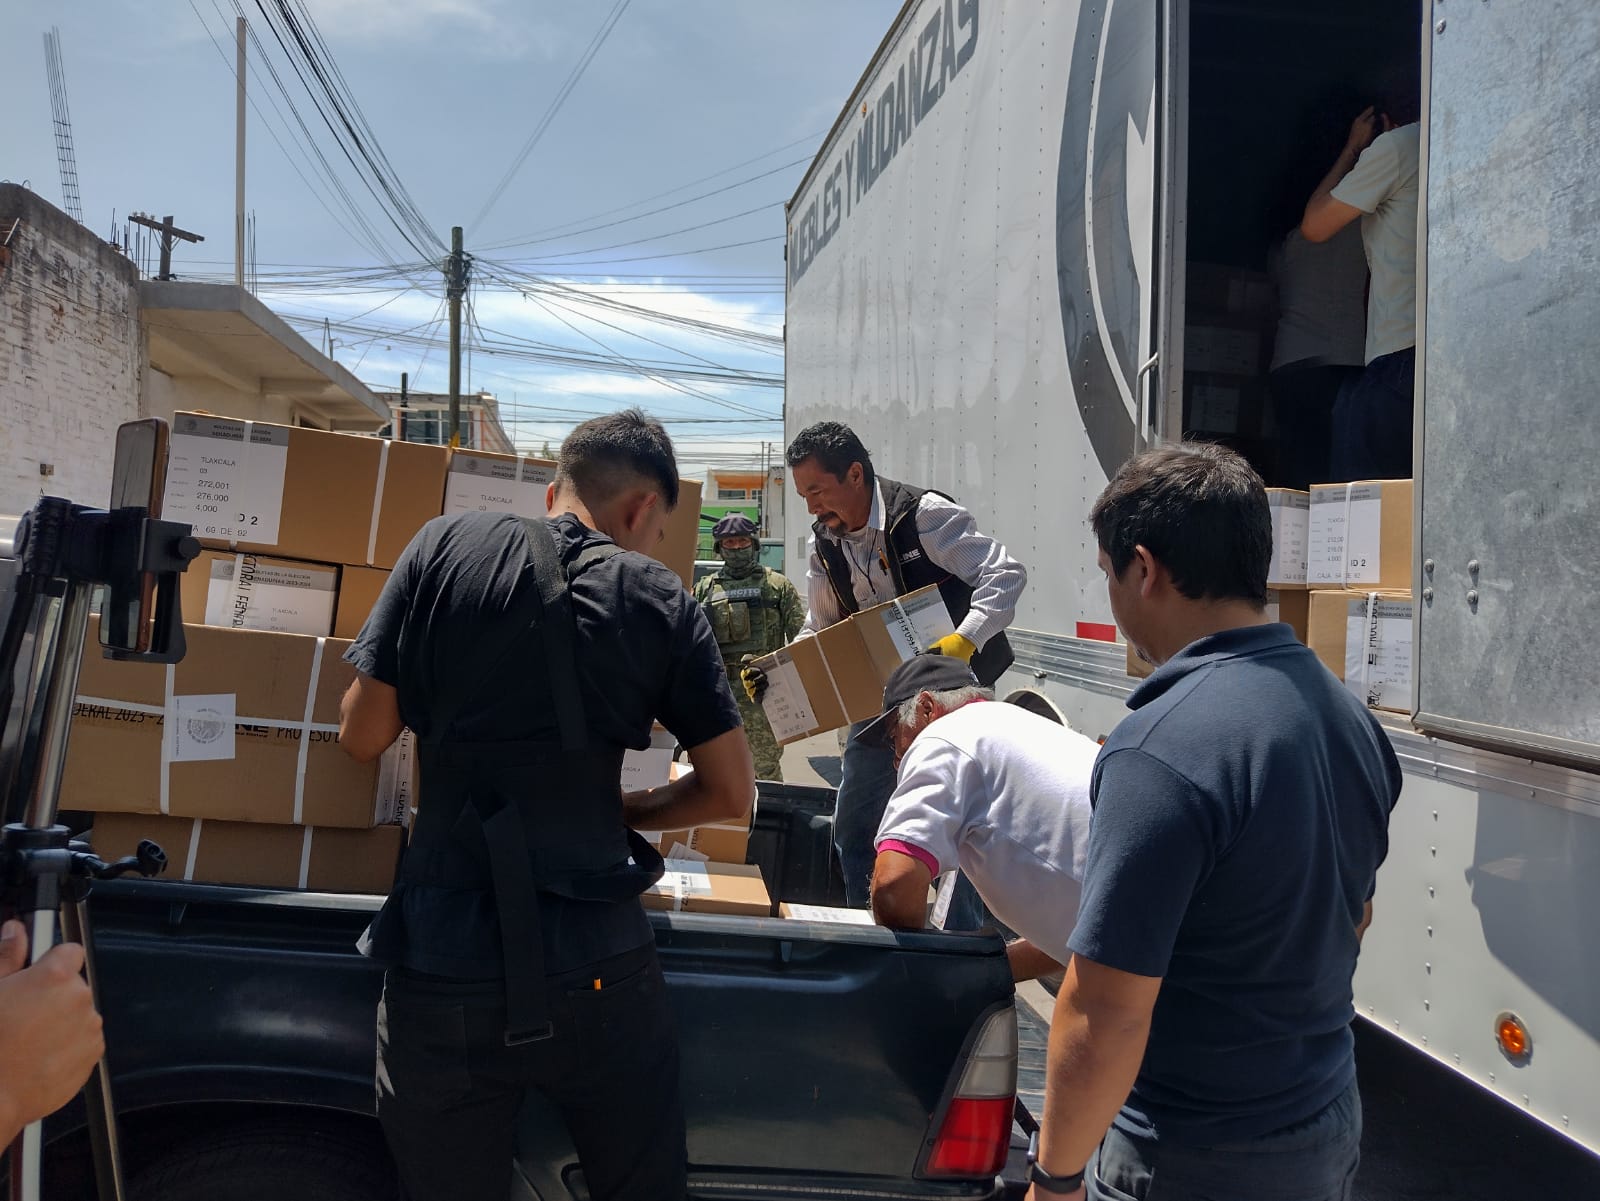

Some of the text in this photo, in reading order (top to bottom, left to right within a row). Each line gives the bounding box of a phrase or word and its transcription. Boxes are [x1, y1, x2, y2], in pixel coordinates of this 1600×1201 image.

[789, 0, 980, 290] MUEBLES Y MUDANZAS
[201, 456, 236, 467] TLAXCALA
[198, 479, 230, 490] 272,001
[196, 491, 229, 502] 276,000
[480, 494, 513, 505] TLAXCALA
[195, 504, 218, 513] 4,000
[250, 516, 258, 525] 2
[1350, 559, 1367, 567] ID 2
[277, 726, 340, 742] PROESO
